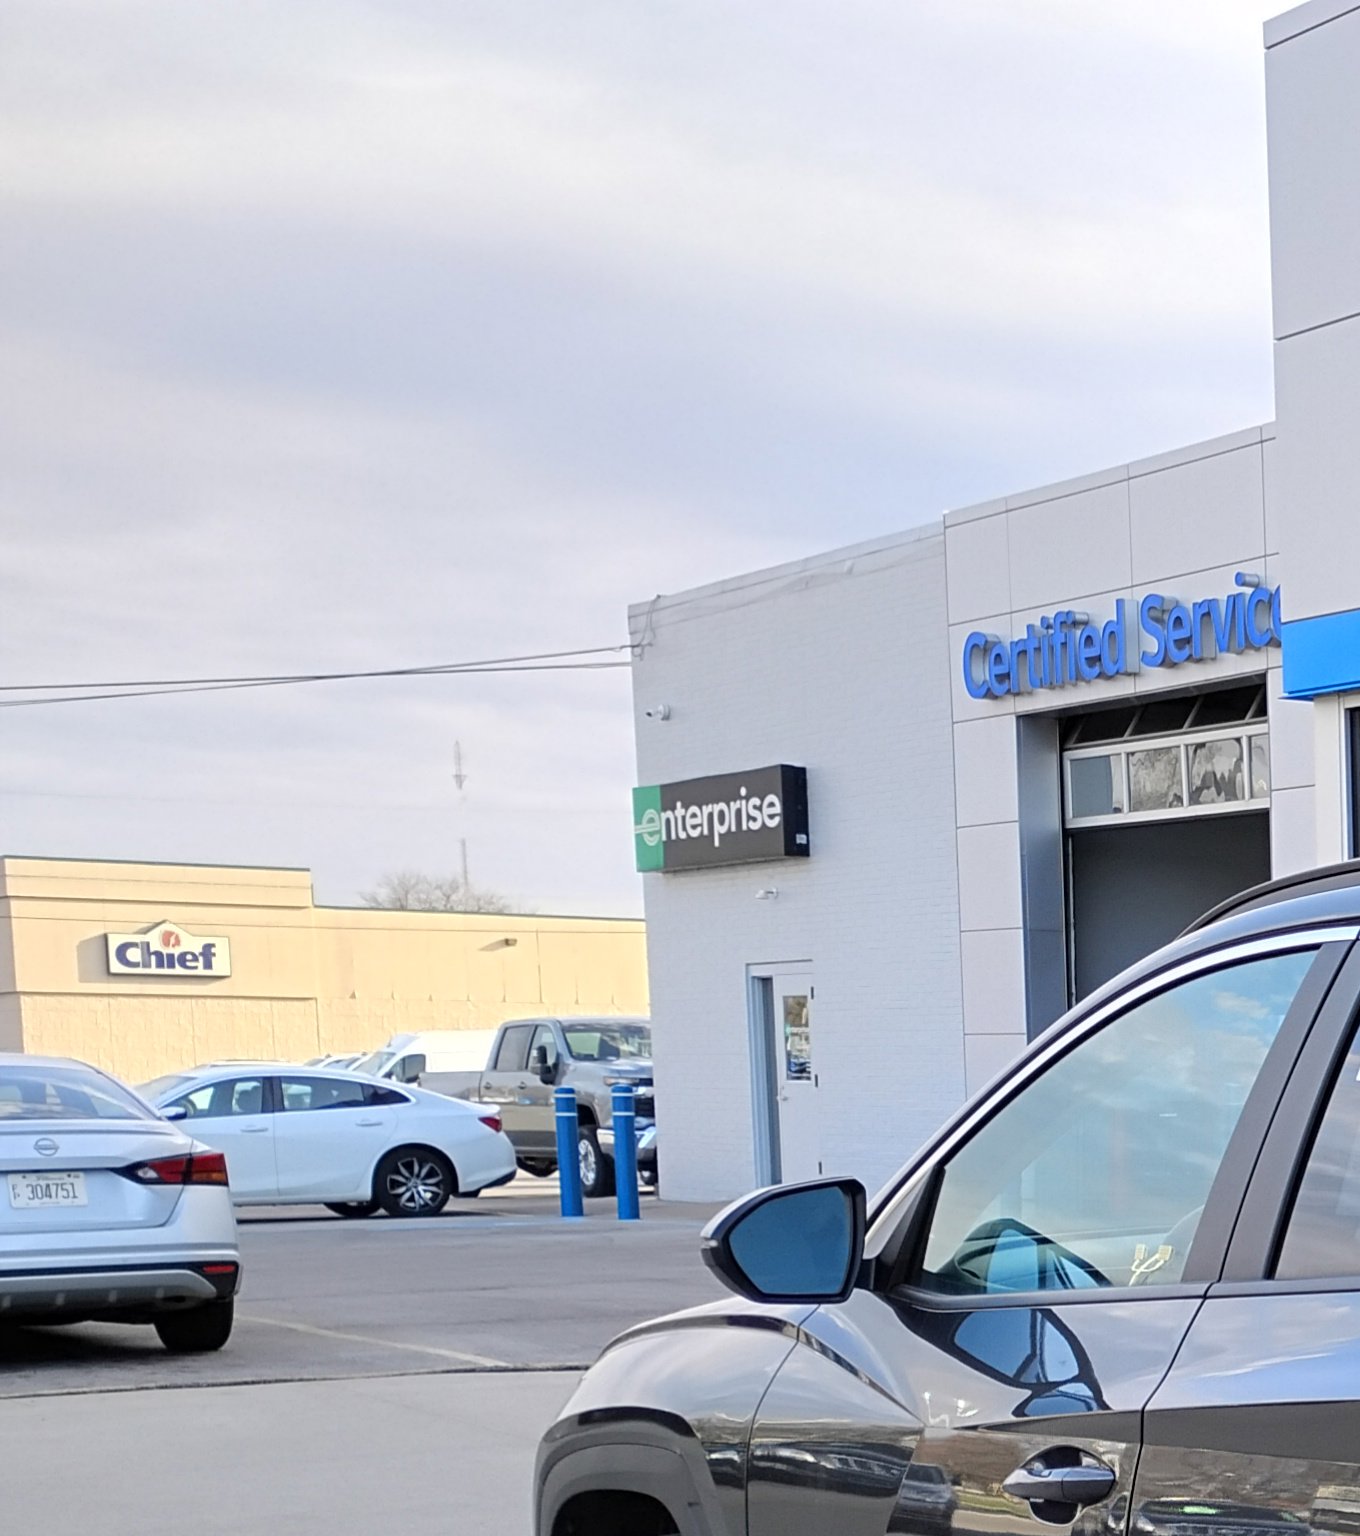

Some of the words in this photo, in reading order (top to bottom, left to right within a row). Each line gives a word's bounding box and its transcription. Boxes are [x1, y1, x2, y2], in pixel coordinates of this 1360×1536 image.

[963, 597, 1130, 700] Certified
[634, 786, 782, 848] enterprise
[114, 940, 217, 971] Chief
[26, 1182, 79, 1201] 304751
